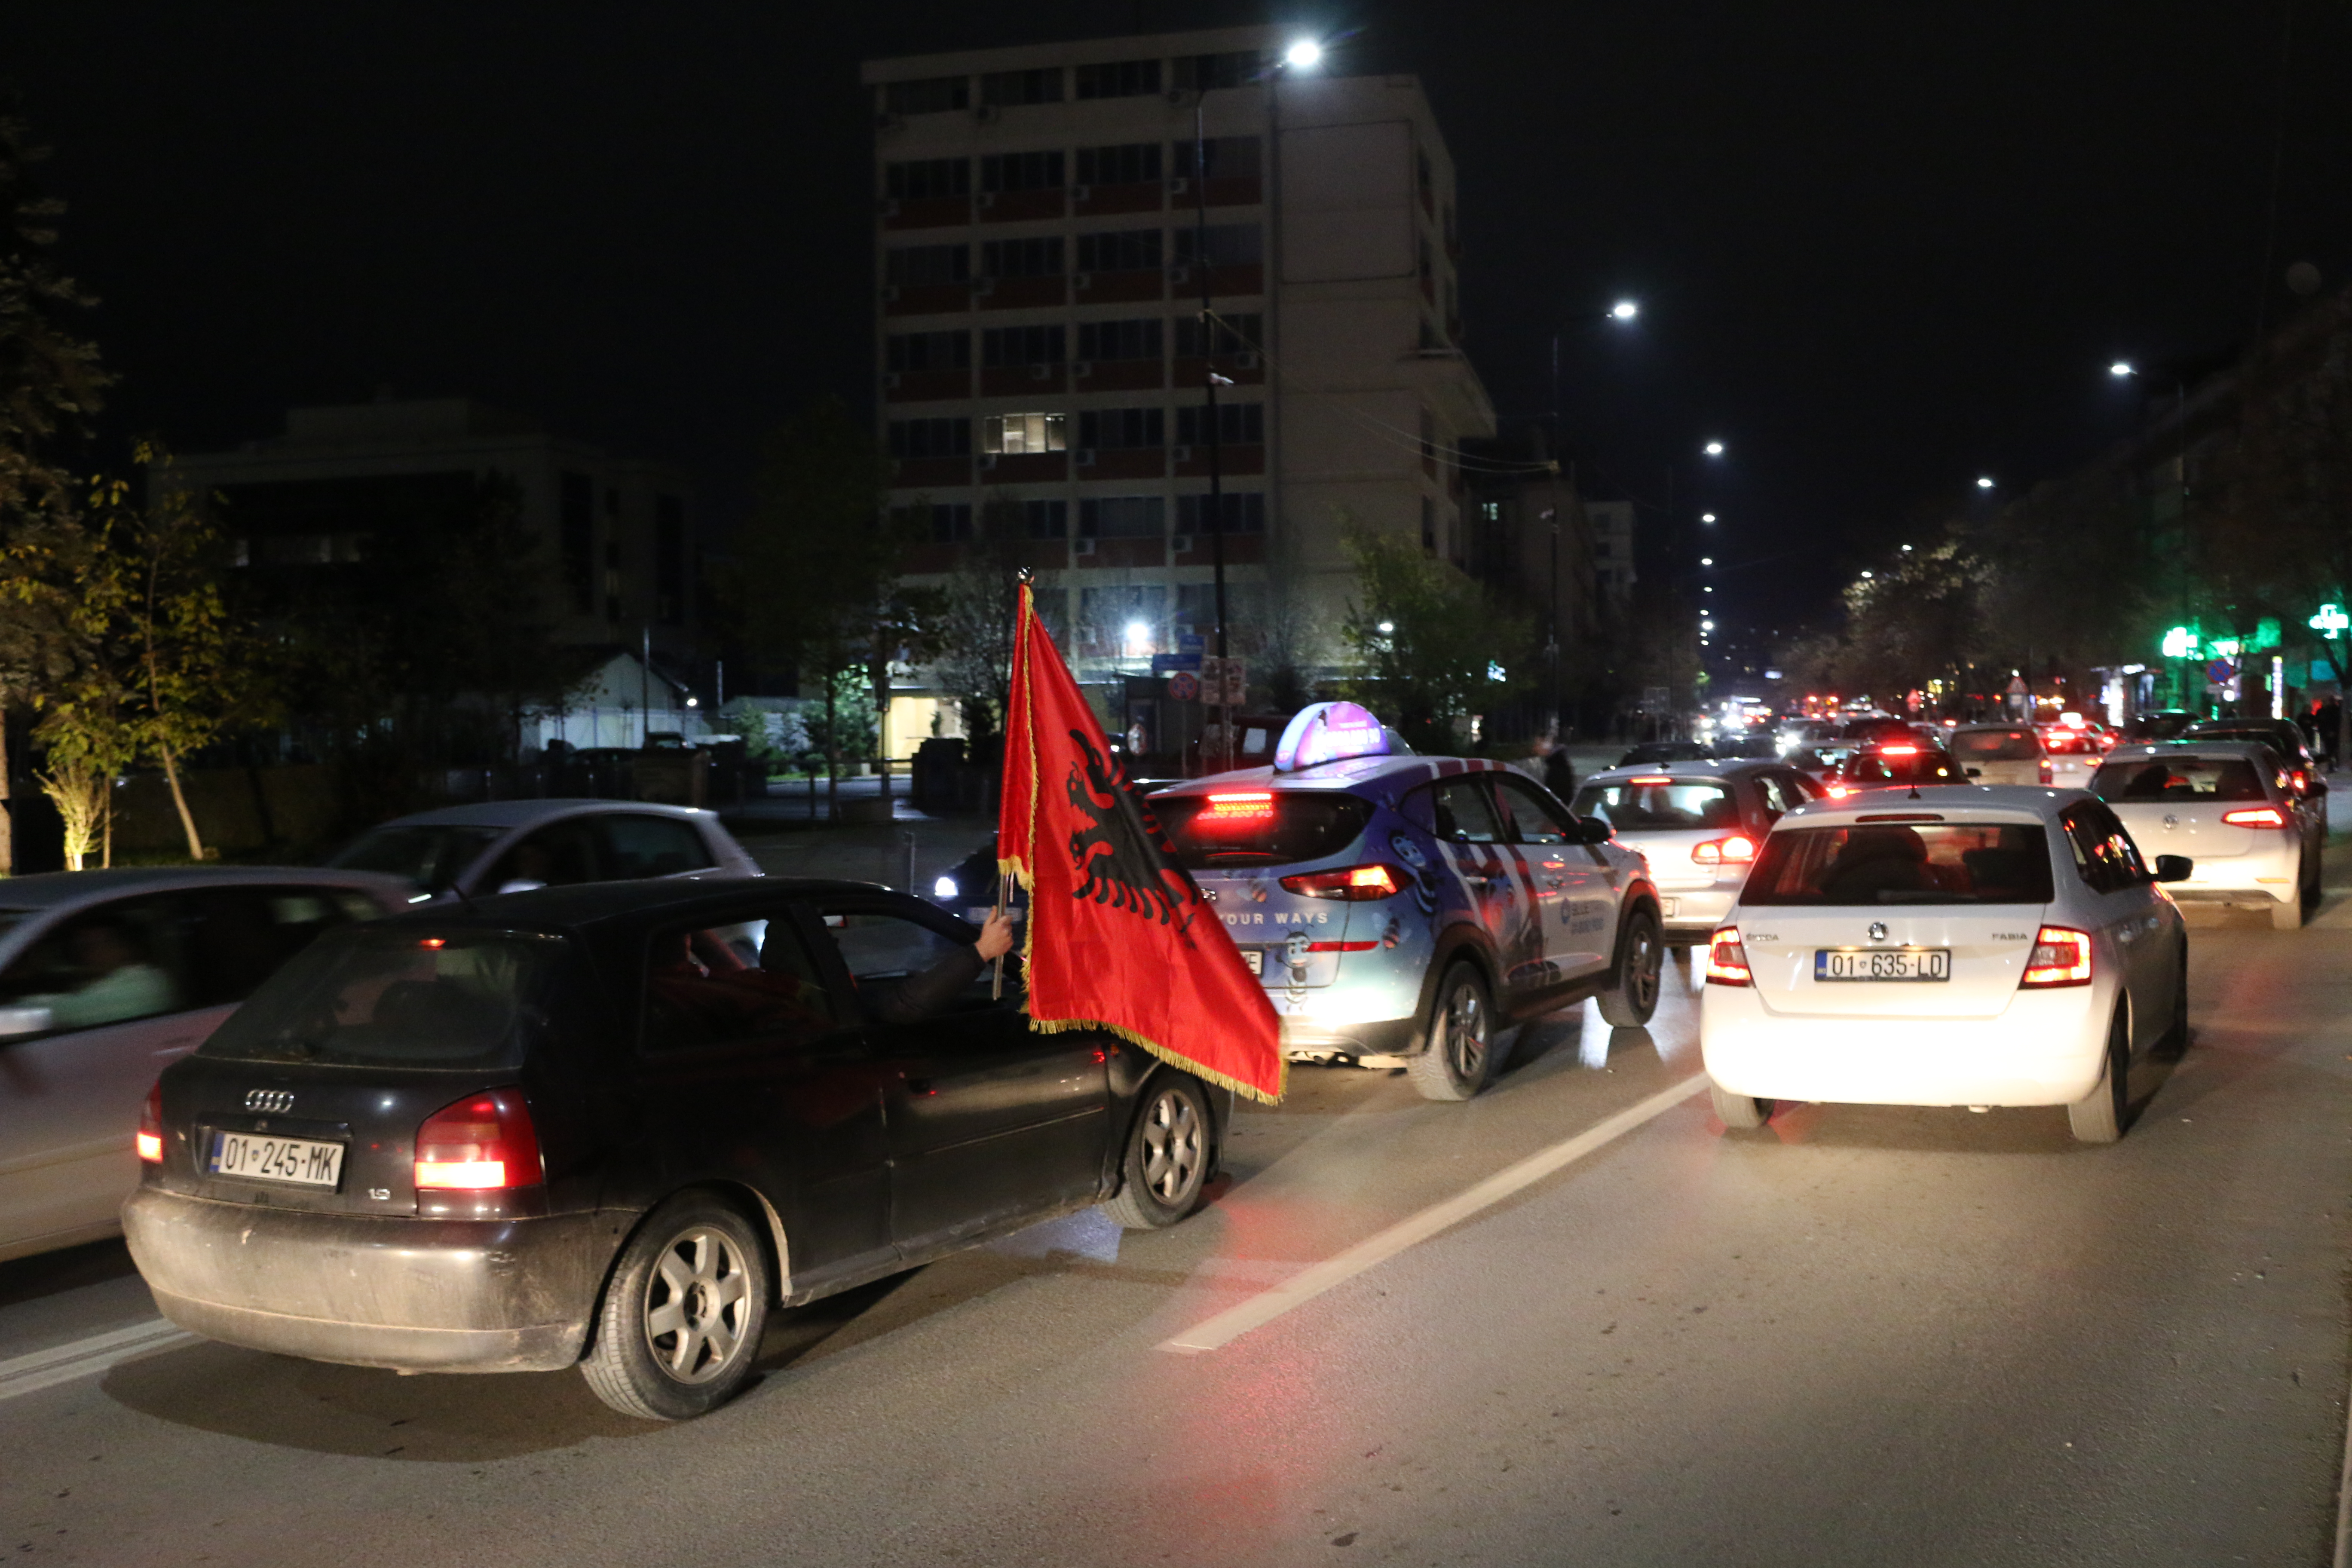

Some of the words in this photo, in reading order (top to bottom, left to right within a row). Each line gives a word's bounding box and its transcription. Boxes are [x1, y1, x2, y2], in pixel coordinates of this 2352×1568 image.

[1275, 912, 1328, 924] WAYS
[1832, 955, 1853, 975] 01
[226, 1137, 249, 1171] 01
